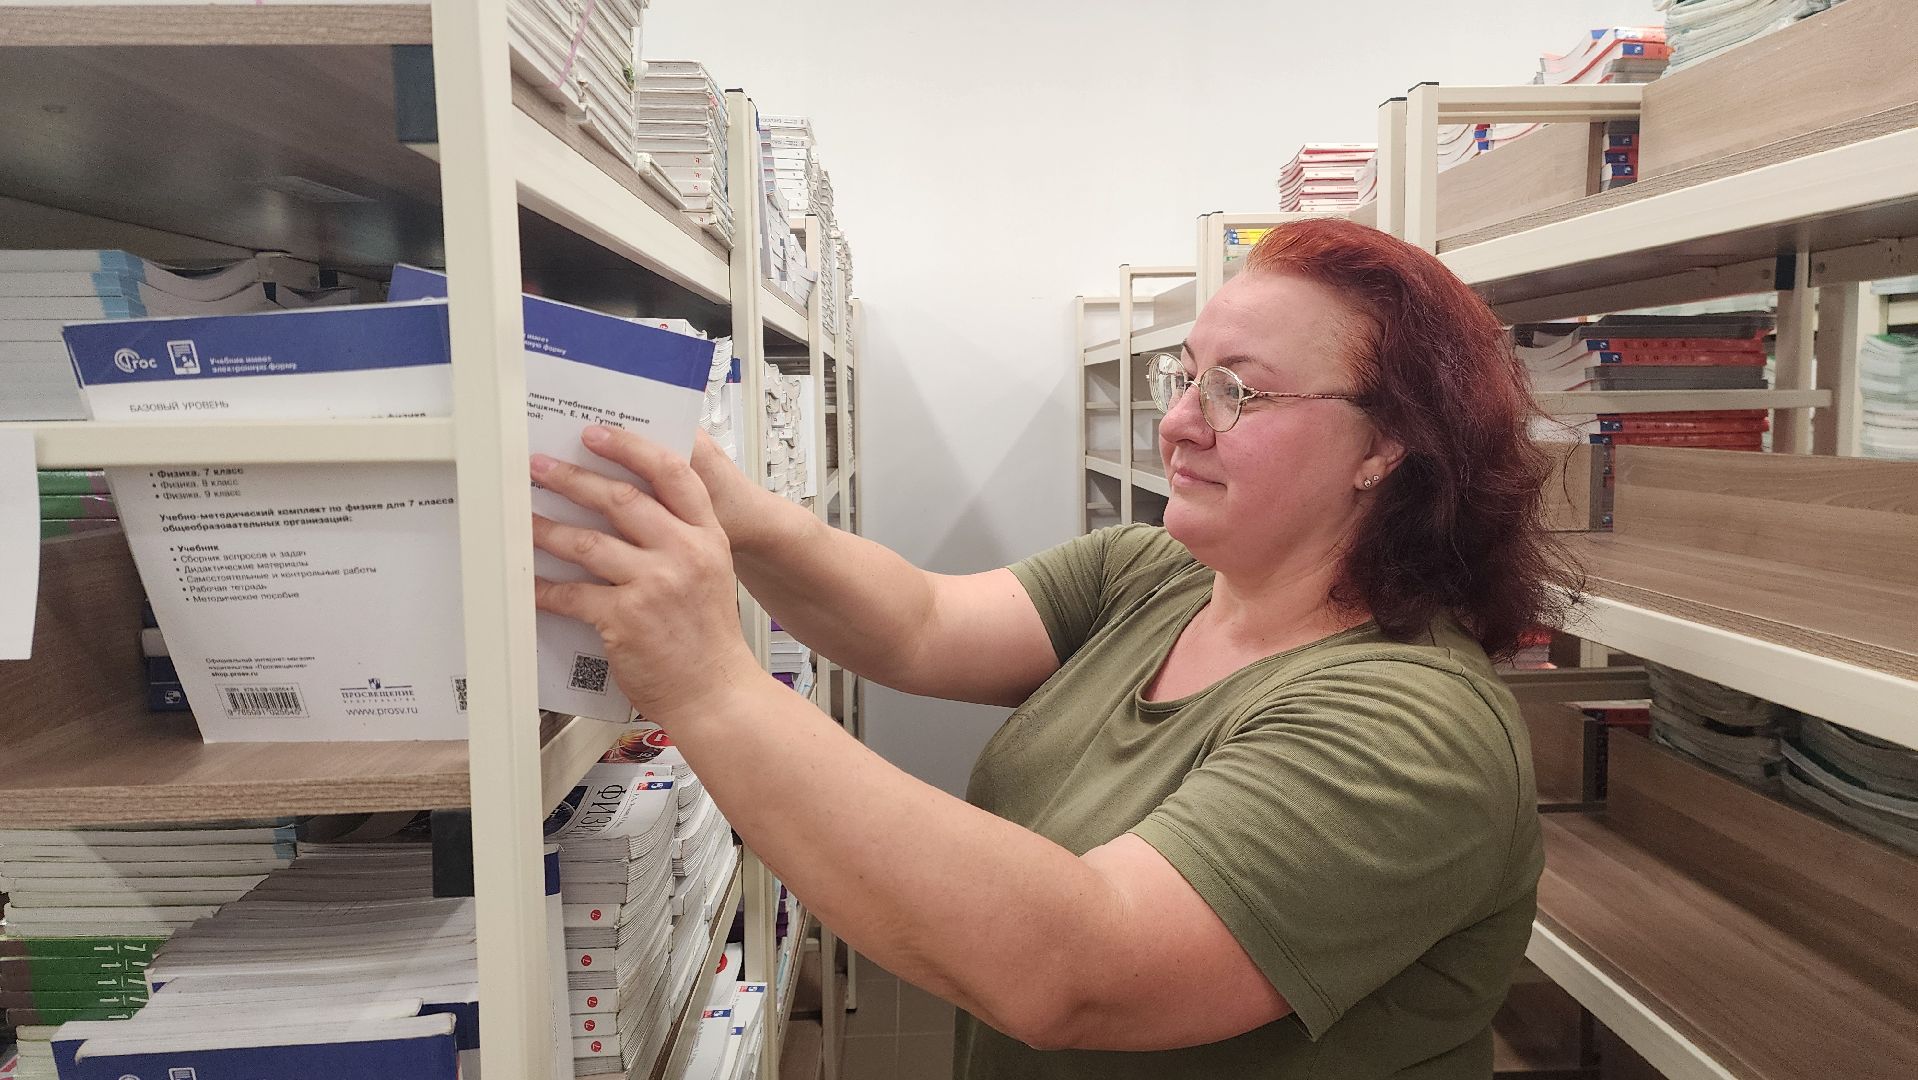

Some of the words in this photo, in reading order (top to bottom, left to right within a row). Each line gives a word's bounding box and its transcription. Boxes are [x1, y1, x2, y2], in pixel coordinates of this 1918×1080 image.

[129, 400, 179, 413] БАЗОВЫЙ
[183, 400, 229, 411] УРОВЕНЬ
[528, 391, 556, 402] линия
[558, 398, 603, 413] учебников
[605, 408, 616, 417] по
[618, 411, 650, 424] физике
[569, 409, 578, 419] Е.
[580, 412, 592, 421] М.
[204, 468, 210, 476] 7
[213, 468, 244, 476] класс
[201, 479, 209, 487] 8
[211, 479, 239, 487] класс
[204, 490, 211, 498] 9
[159, 508, 274, 522] Учебно-методический
[277, 506, 326, 516] комплект
[345, 502, 384, 512] физике
[386, 501, 406, 510] для
[408, 499, 414, 507] 7
[418, 497, 455, 506] класса
[162, 520, 280, 533] общеобразовательных
[283, 514, 353, 527] организаций:
[177, 544, 220, 553] Учебник
[180, 554, 220, 564] Сборник
[223, 552, 268, 562] вопросов
[184, 563, 254, 574] Дидактические
[256, 560, 309, 571] материалы
[186, 573, 269, 583] Самостоятельные
[280, 569, 340, 579] контрольные
[342, 566, 377, 576] работы
[189, 583, 228, 593] Рабочая
[230, 584, 268, 592] тетрадь
[193, 593, 259, 603] Методическое
[261, 591, 300, 601] пособие
[341, 689, 415, 699] ПРОСВЕЩЕНИЕ
[345, 706, 419, 717] www.prosv.ru
